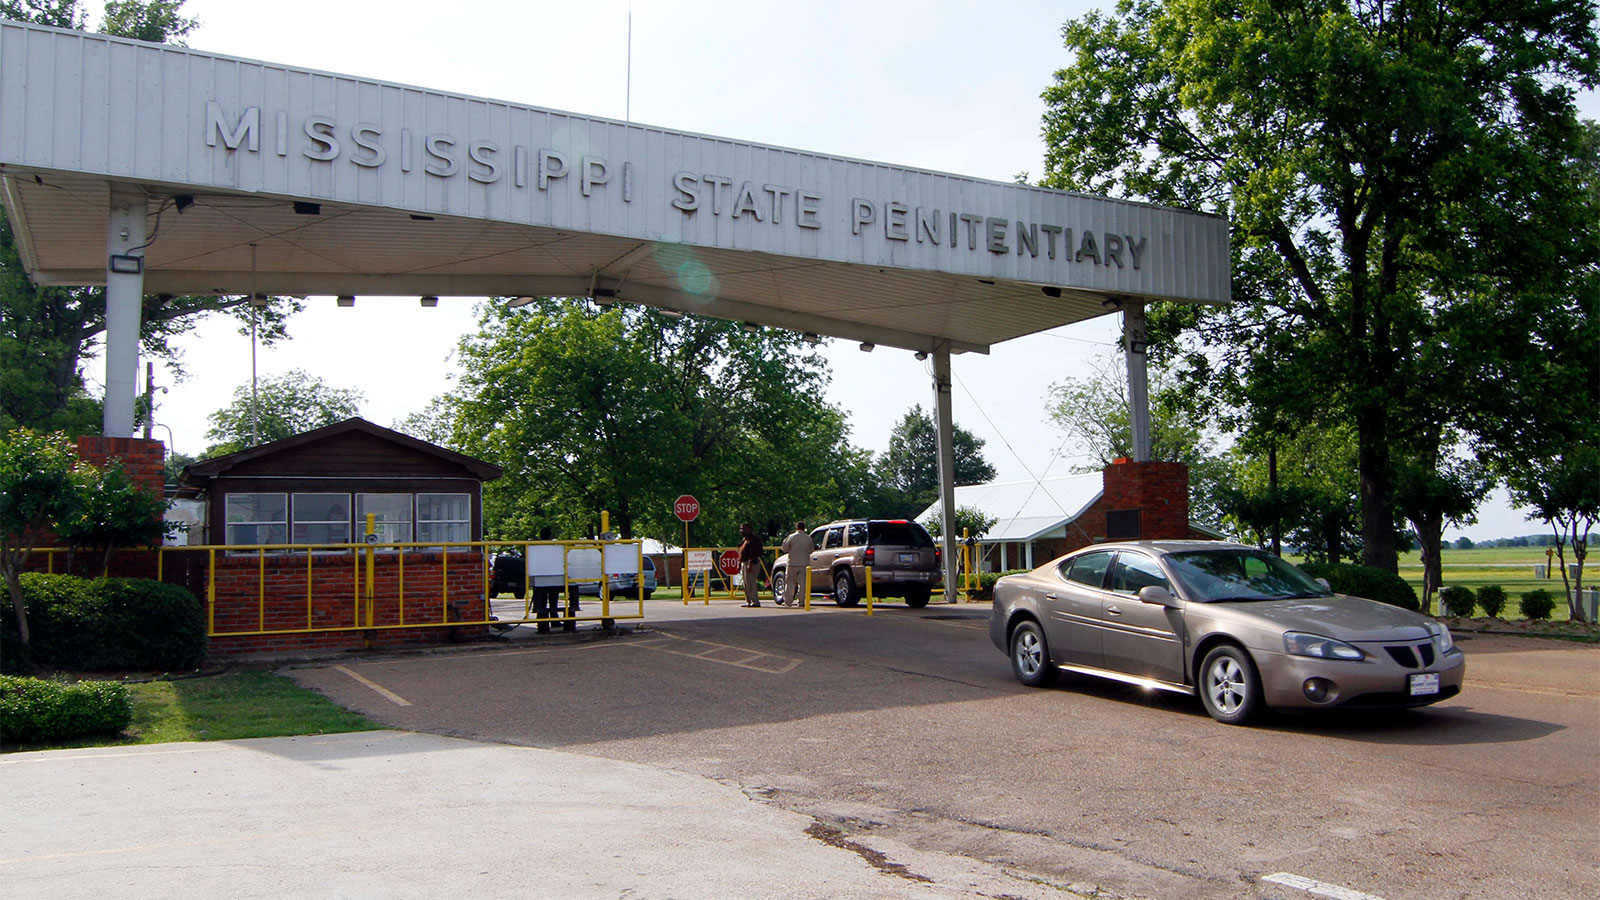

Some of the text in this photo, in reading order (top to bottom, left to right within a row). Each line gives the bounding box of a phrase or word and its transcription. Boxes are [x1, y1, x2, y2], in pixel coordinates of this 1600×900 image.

[206, 100, 1147, 270] MISSISSIPPI STATE PENITENTIARY
[676, 503, 698, 514] STOP
